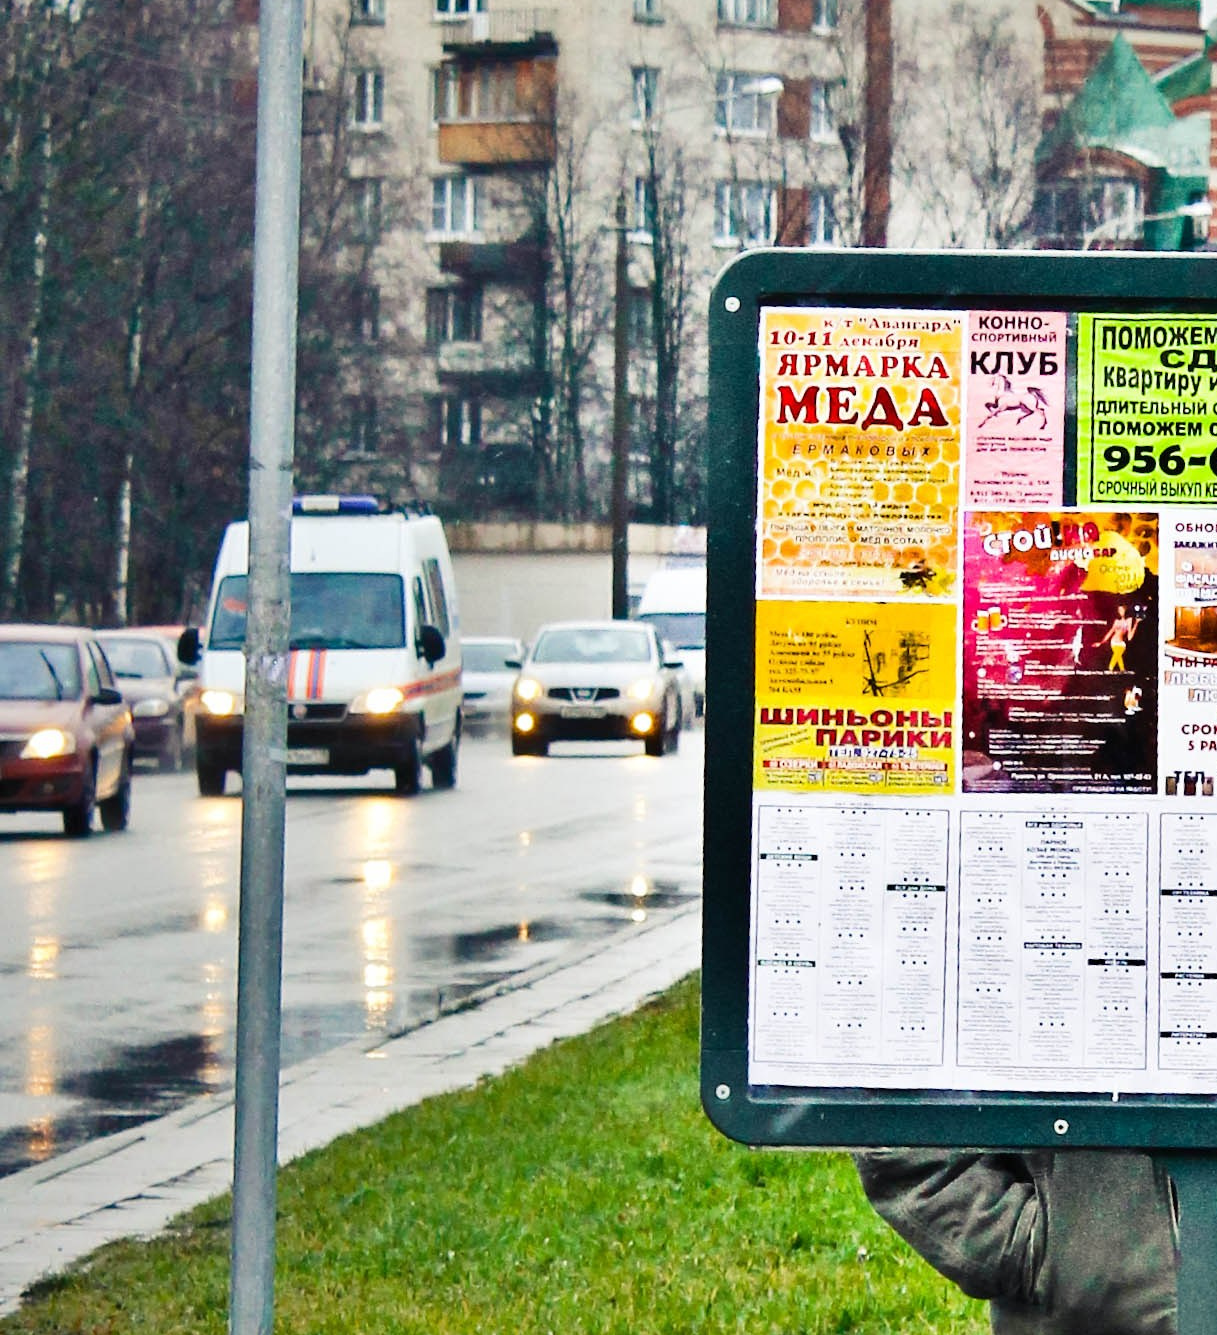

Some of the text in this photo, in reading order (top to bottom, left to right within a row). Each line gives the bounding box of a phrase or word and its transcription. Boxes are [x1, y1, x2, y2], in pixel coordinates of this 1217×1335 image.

[979, 316, 1049, 330] КОННО-
[770, 330, 918, 349] 10-11 декабря
[971, 332, 1056, 342] СПОРТИВНЫЙ
[777, 354, 949, 378] ЯРМАРКА
[970, 351, 1058, 375] КЛУБ
[777, 386, 949, 431] МЕДА
[1096, 399, 1207, 416] ДЛИТЕЛЬНЫЙ
[1098, 420, 1202, 436] ПОМОЖЕМ
[792, 445, 930, 456] ЕРМАКОВЫХ
[1098, 479, 1157, 495] СРОЧНЫЙ
[1160, 482, 1202, 497] ВЫКУП
[1172, 657, 1198, 667] МЫ
[760, 708, 952, 728] ШИНЬОНЫ
[816, 729, 952, 748] ПАРИКИ
[1188, 741, 1194, 751] 5
